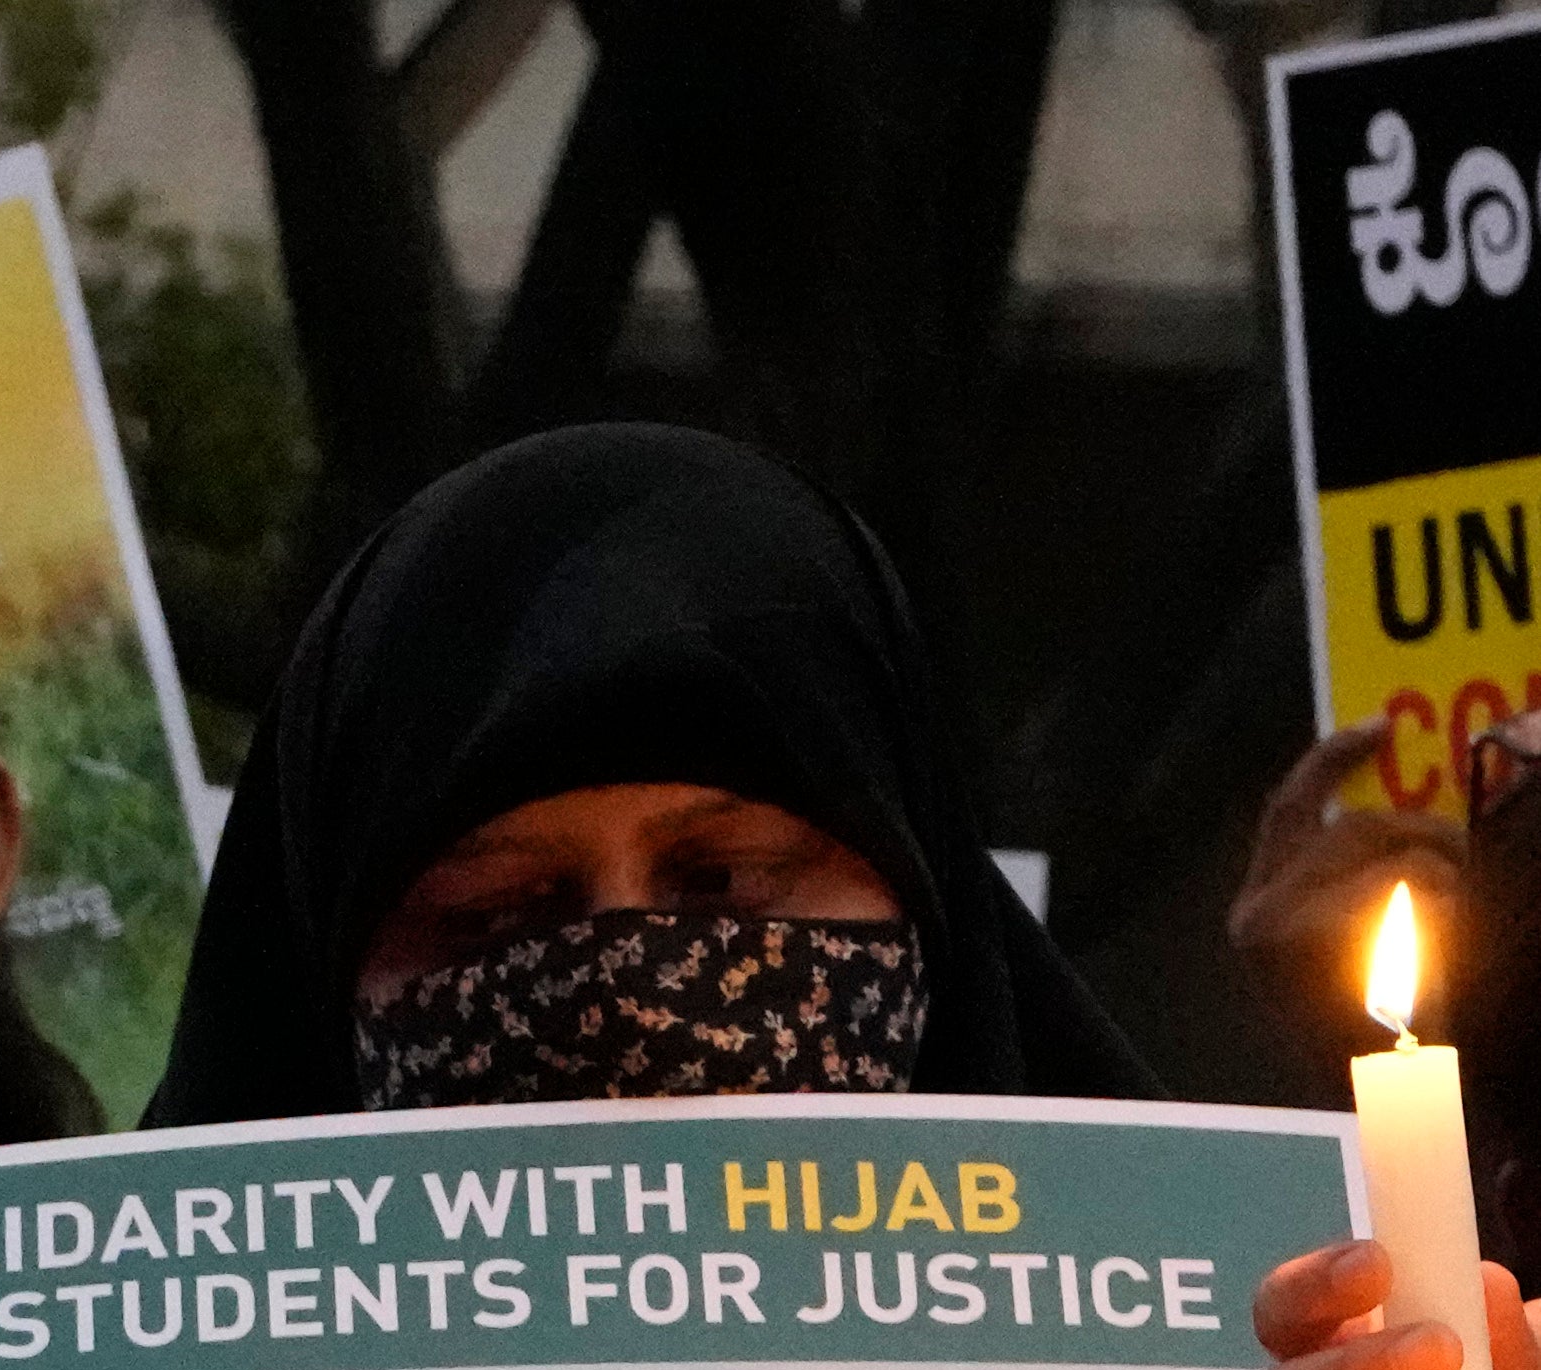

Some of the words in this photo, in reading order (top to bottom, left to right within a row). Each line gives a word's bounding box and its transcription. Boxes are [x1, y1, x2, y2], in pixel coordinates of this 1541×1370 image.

[1371, 504, 1533, 643] UN
[1376, 668, 1541, 812] CO
[423, 1162, 687, 1240] WITH
[724, 1160, 1022, 1233] HIJAB
[567, 1253, 763, 1327] FOR
[796, 1253, 1221, 1332] JUSTICE
